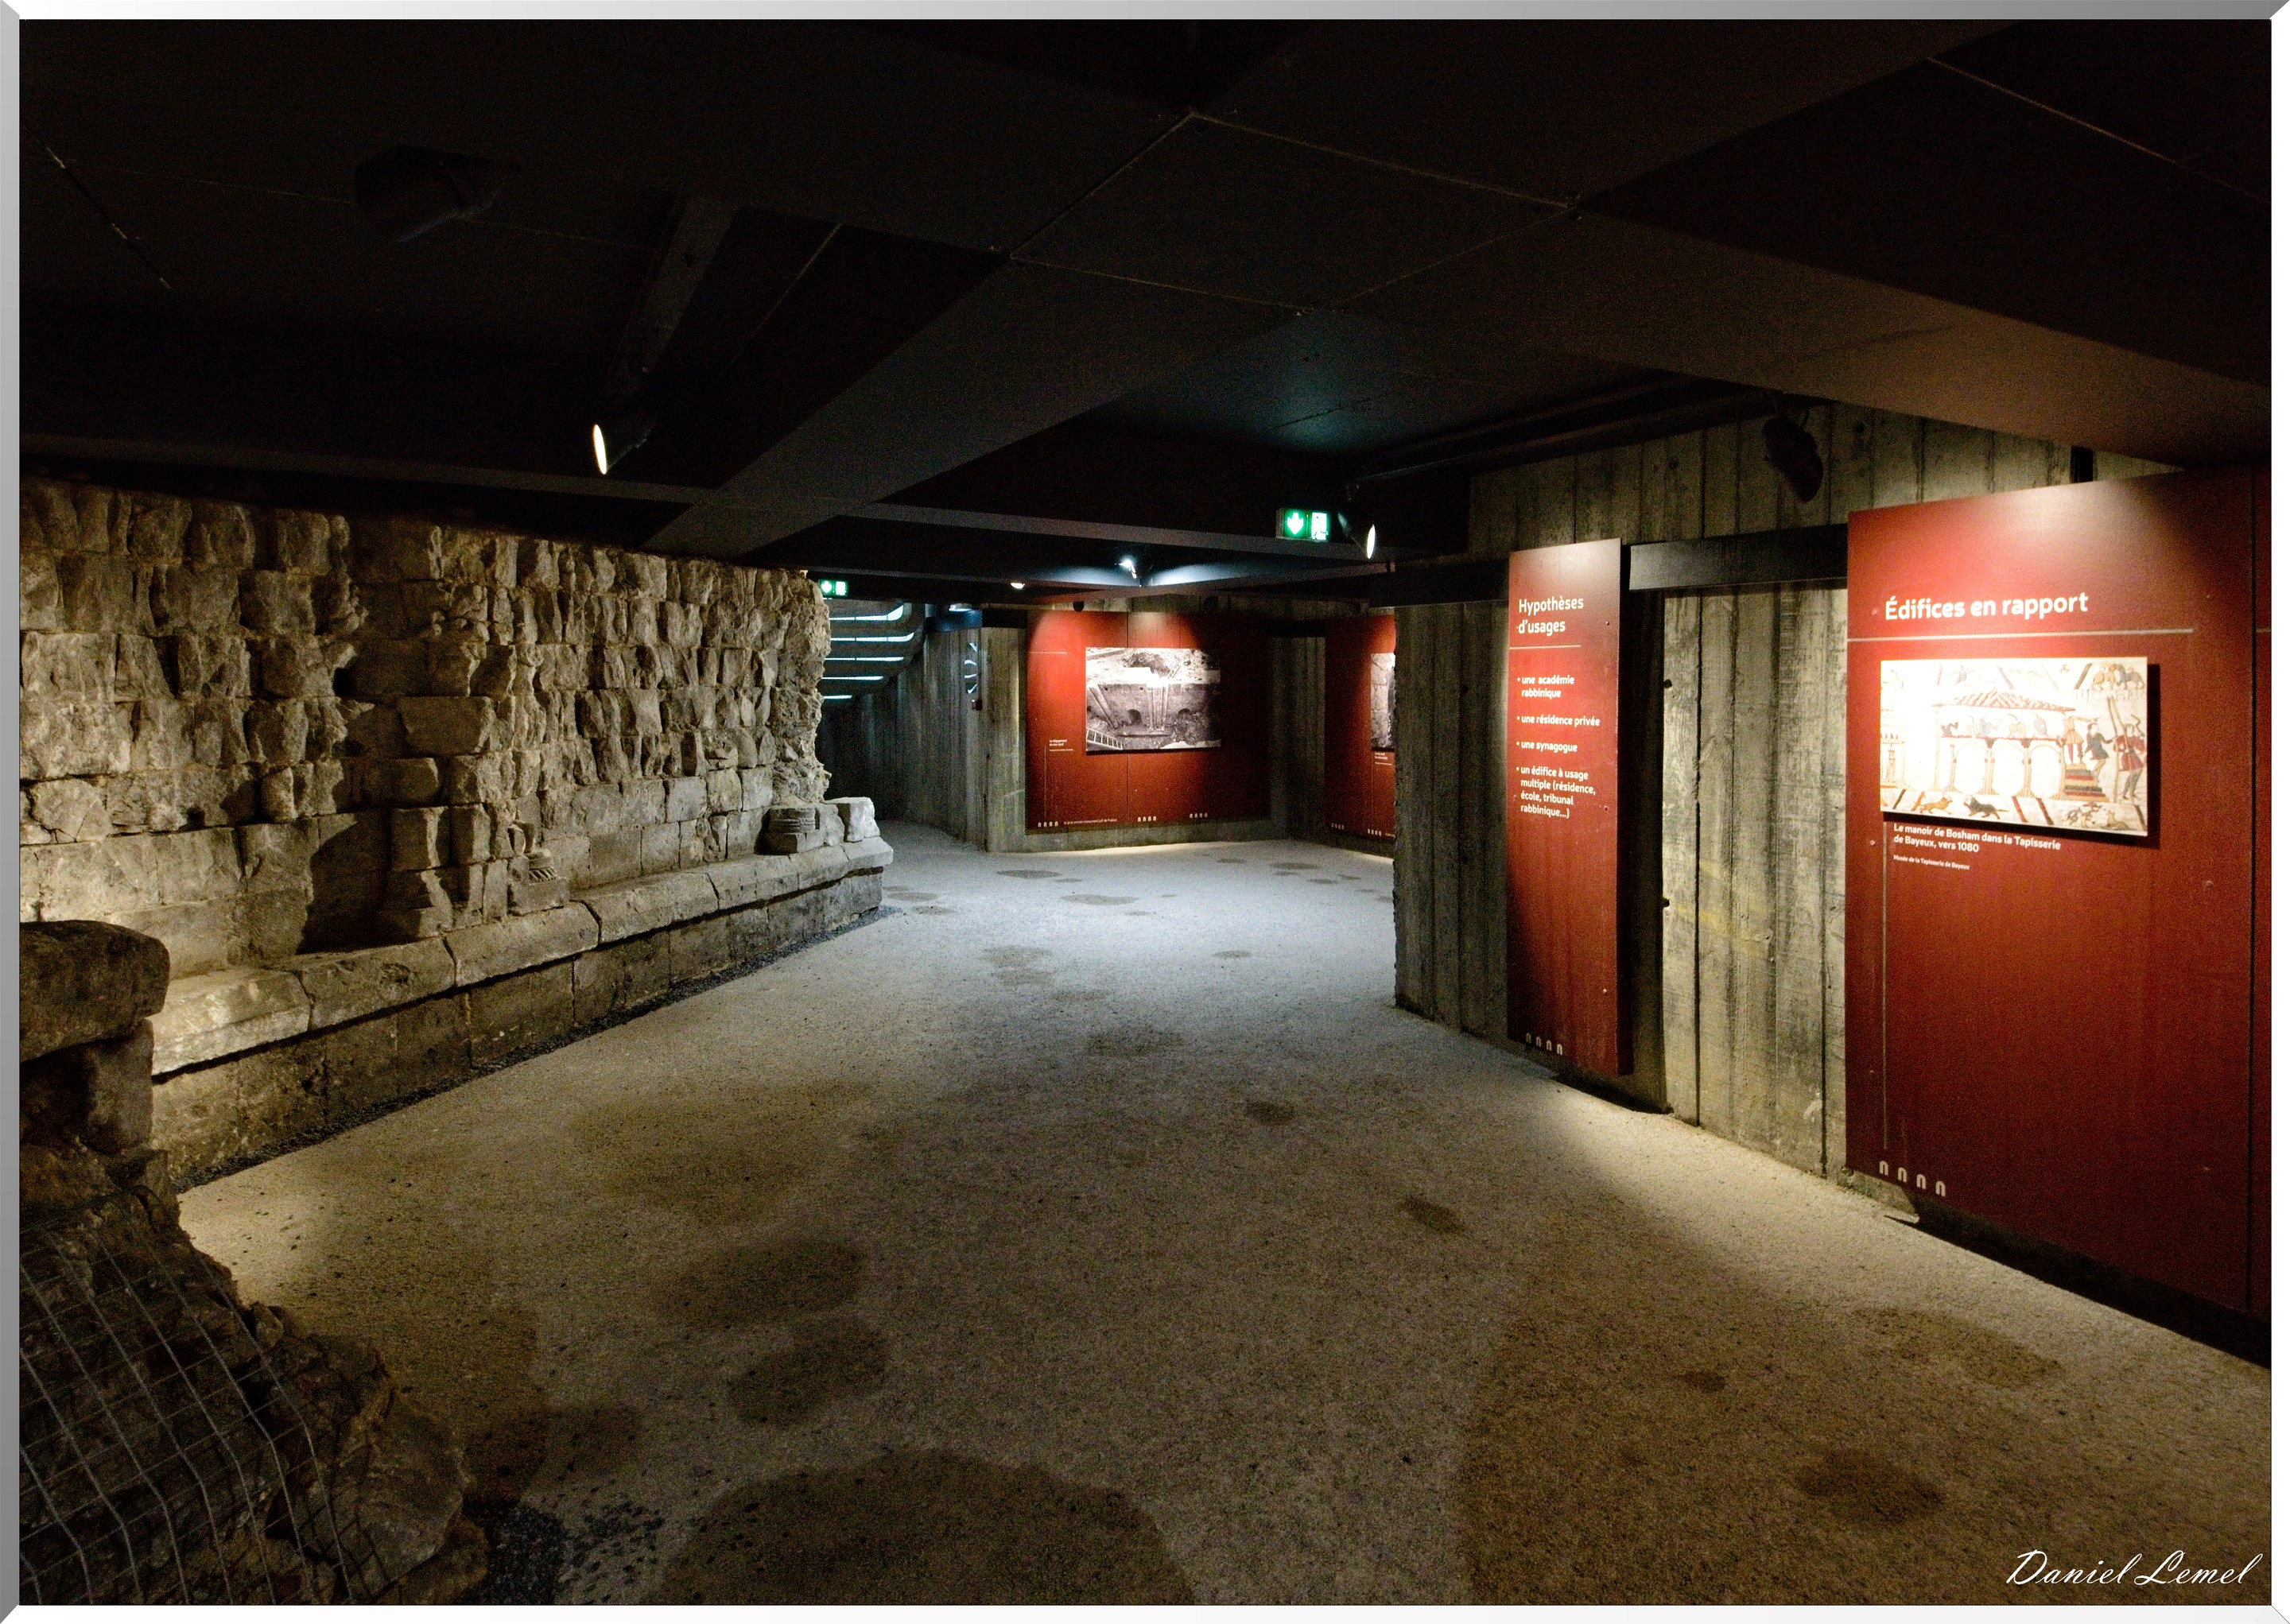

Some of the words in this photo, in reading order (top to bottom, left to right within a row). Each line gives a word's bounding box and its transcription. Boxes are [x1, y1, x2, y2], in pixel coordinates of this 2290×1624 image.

[1519, 595, 1584, 616] Hypothèses
[1885, 595, 1965, 620] Édifices
[1970, 600, 1996, 617] en
[2002, 592, 2089, 620] rapport
[1518, 618, 1566, 637] d'usages
[1538, 674, 1575, 684] académie
[1521, 688, 1562, 700] rabbinique
[1536, 714, 1574, 725] résidence
[1574, 715, 1601, 727] privée
[1535, 742, 1578, 754] synagogue
[1531, 765, 1557, 777] édifice
[1558, 768, 1563, 777] à
[1564, 771, 1589, 781] usage
[1520, 778, 1551, 790] multiple
[1552, 780, 1596, 796] (résidence,
[1520, 790, 1542, 802] école,
[1543, 793, 1574, 805] tribunal
[1893, 823, 1904, 832] Le
[1904, 824, 1932, 835] manoir
[1934, 828, 1945, 837] de
[1946, 828, 1980, 841] Bosham
[1981, 832, 2001, 844] dans
[2004, 835, 2012, 845] la
[2014, 835, 2061, 850] Tapisserie
[1904, 835, 1937, 848] Bayeux,
[1938, 840, 1956, 850] vers
[1957, 842, 1979, 854] 1080
